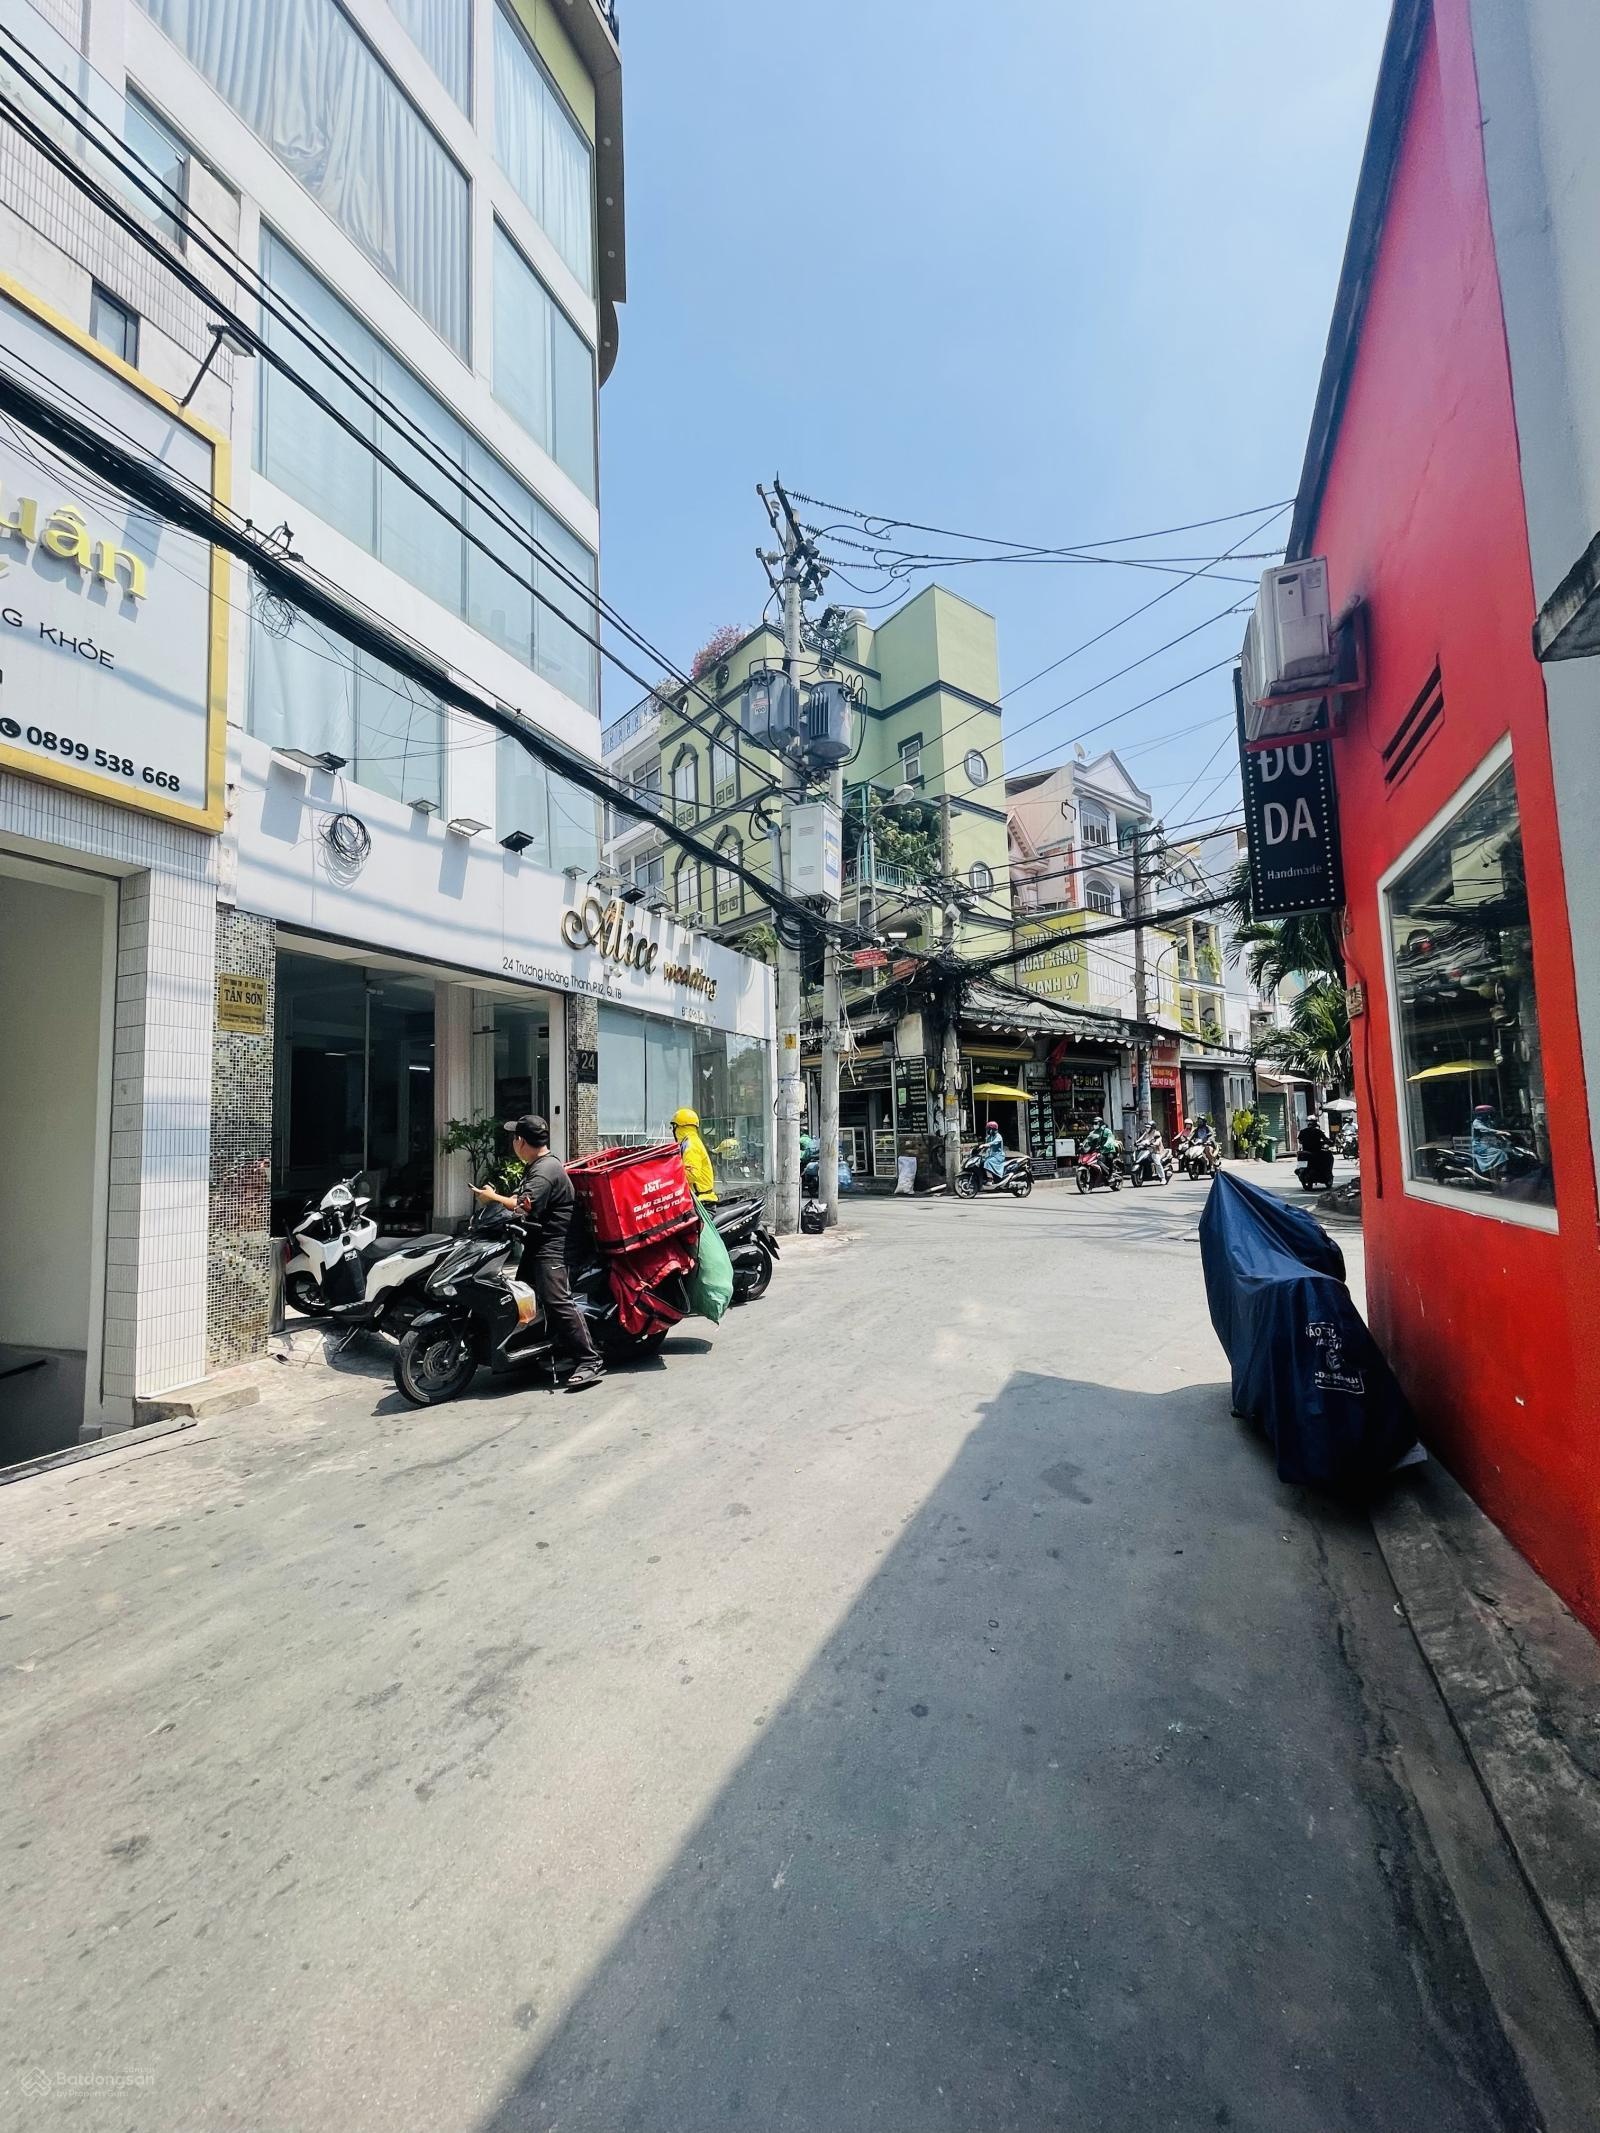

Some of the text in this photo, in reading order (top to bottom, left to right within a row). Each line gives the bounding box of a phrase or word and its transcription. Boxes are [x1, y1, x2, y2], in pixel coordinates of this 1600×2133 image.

[40, 622, 115, 669] KHỎE
[26, 726, 180, 792] 0899 538 668
[1263, 797, 1317, 846] DA
[1266, 863, 1323, 880] Handmade
[561, 897, 659, 975] Alice
[503, 956, 514, 980] 24
[581, 1052, 595, 1071] 24
[642, 1179, 661, 1195] J&T
